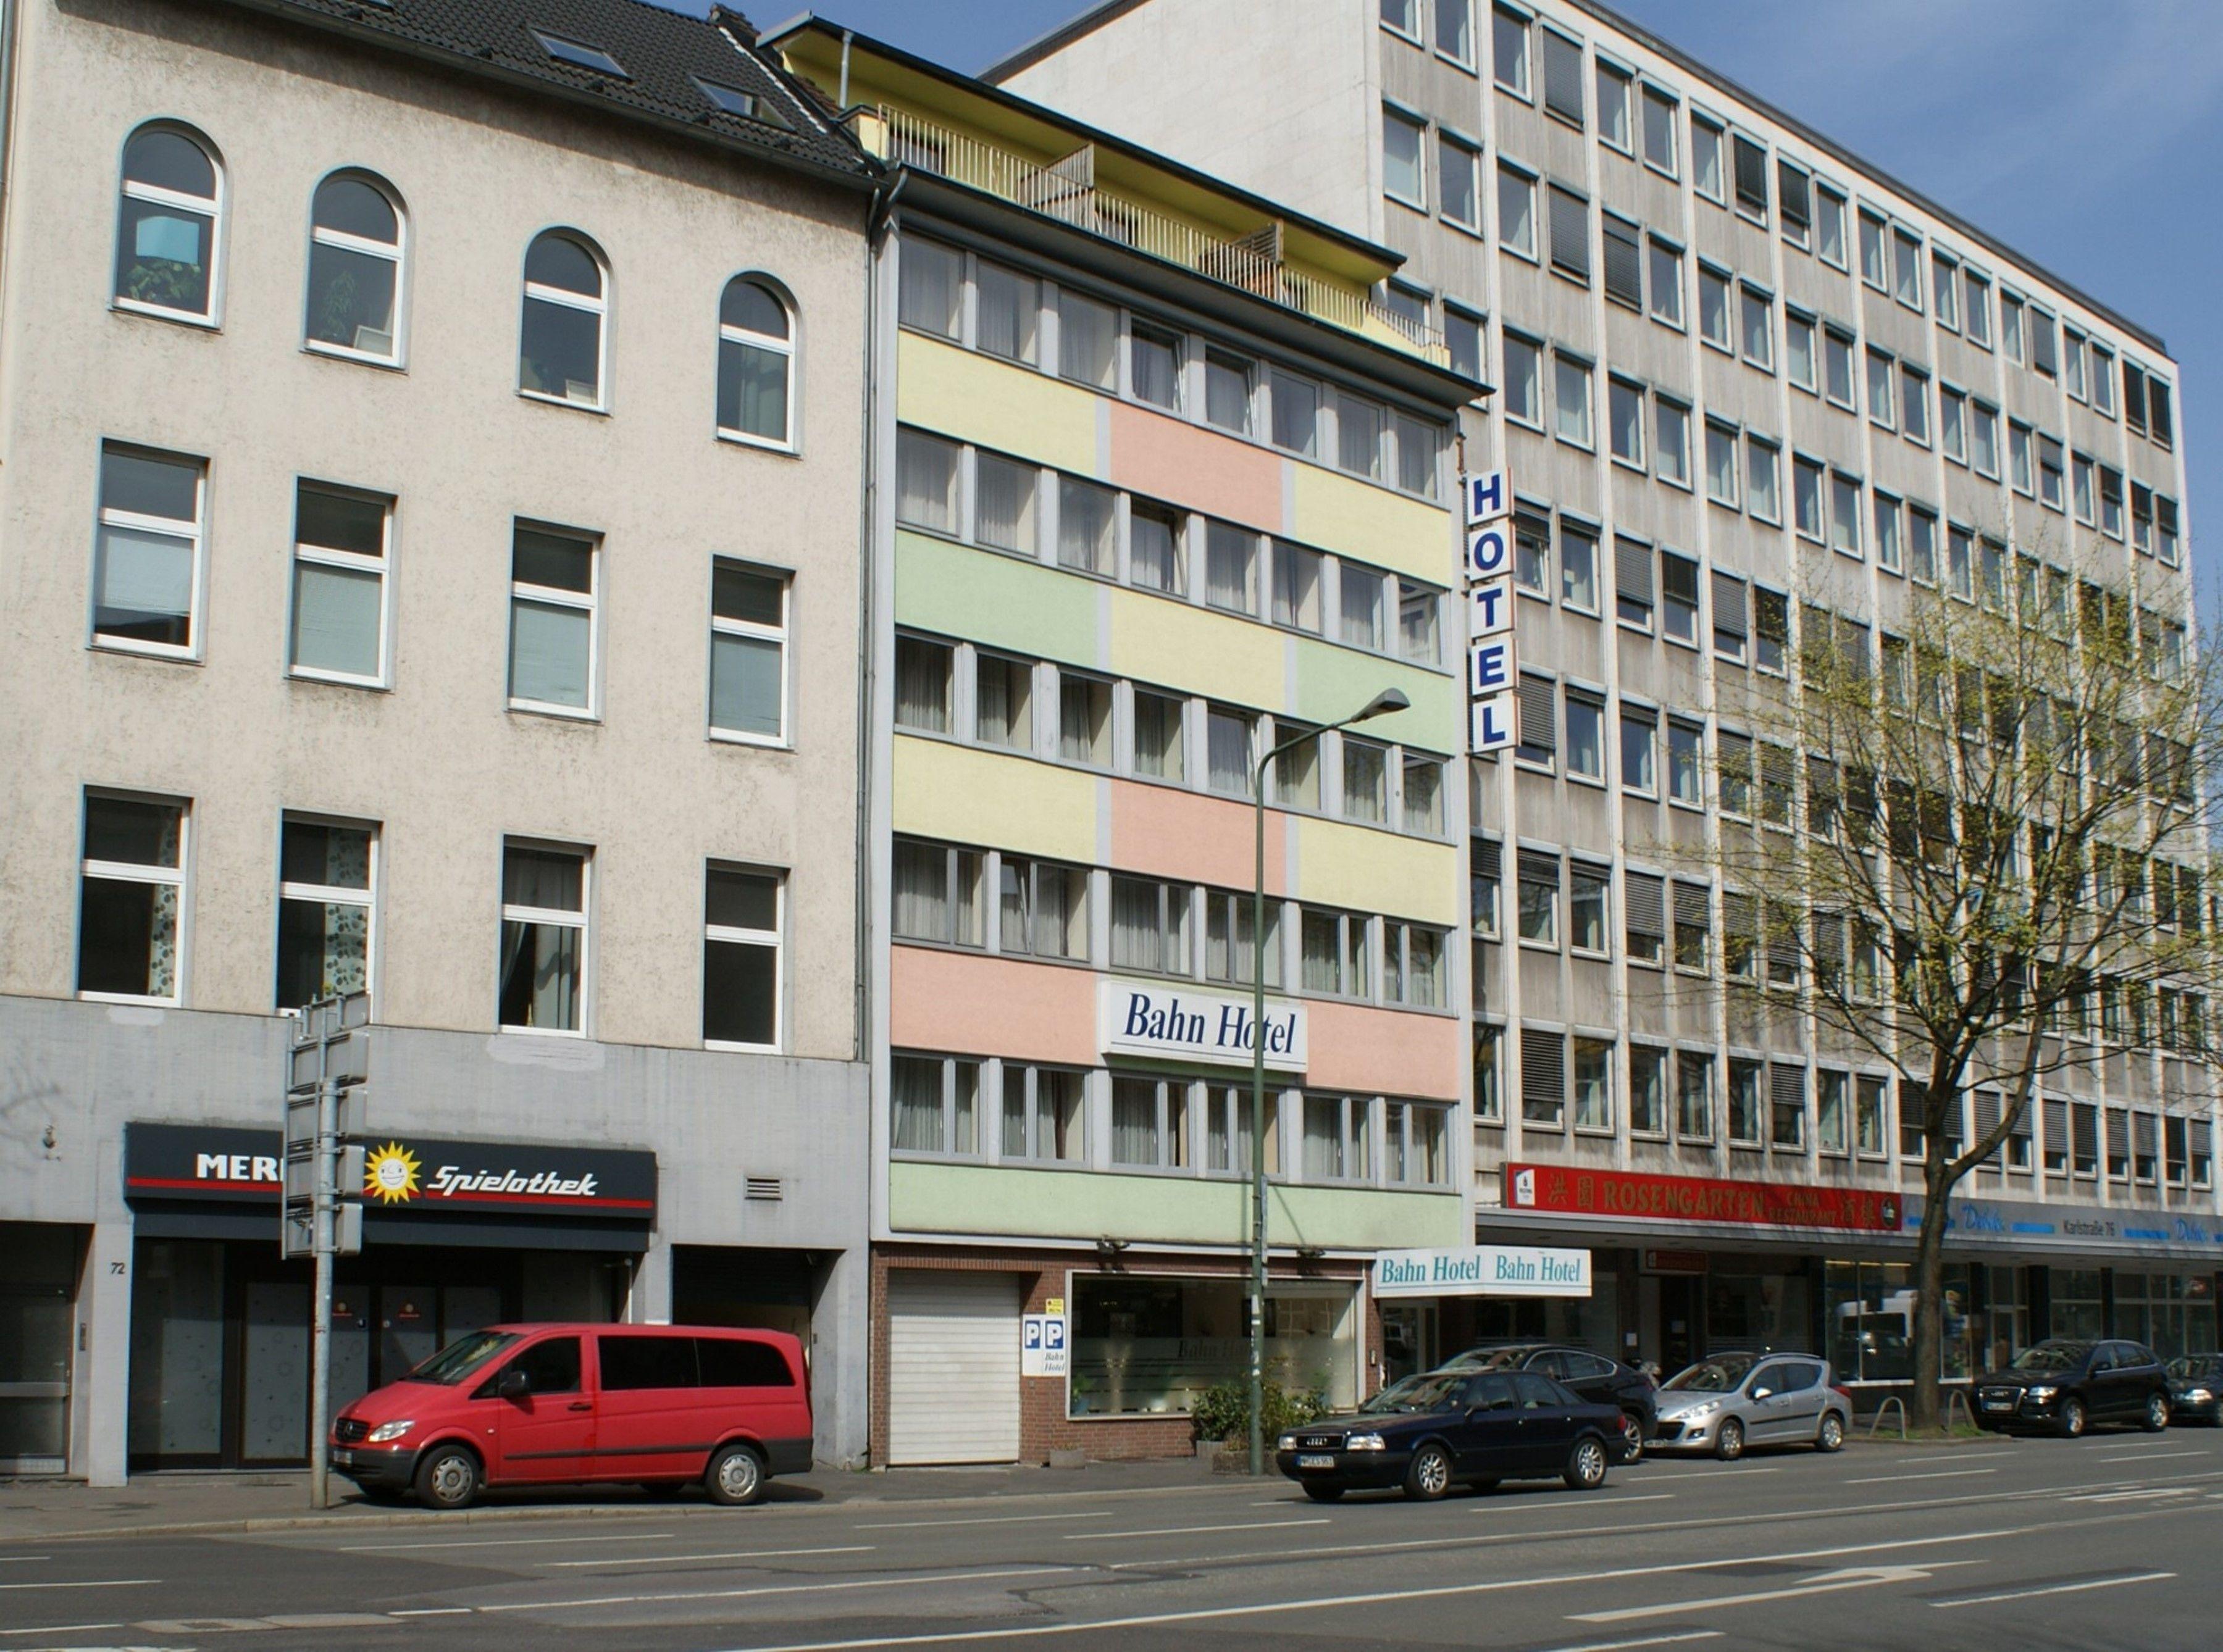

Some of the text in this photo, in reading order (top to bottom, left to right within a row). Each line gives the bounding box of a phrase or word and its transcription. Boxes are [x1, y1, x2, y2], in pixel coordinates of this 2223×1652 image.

[1473, 473, 1505, 744] HOTEL
[1123, 993, 1296, 1053] Bahn Hotel
[197, 1154, 284, 1182] MER
[427, 1166, 598, 1196] Spielothek
[1604, 1180, 1764, 1219] ROSENGARTEN
[1787, 1191, 1820, 1208] CHINA
[1769, 1207, 1836, 1225] RESTAURANT
[111, 1262, 125, 1275] 72
[1381, 1254, 1480, 1283] Bahn Hotel
[1495, 1254, 1580, 1282] Bahn Hotel
[1044, 1362, 1065, 1372] Hotel
[1045, 1352, 1064, 1361] Bahn
